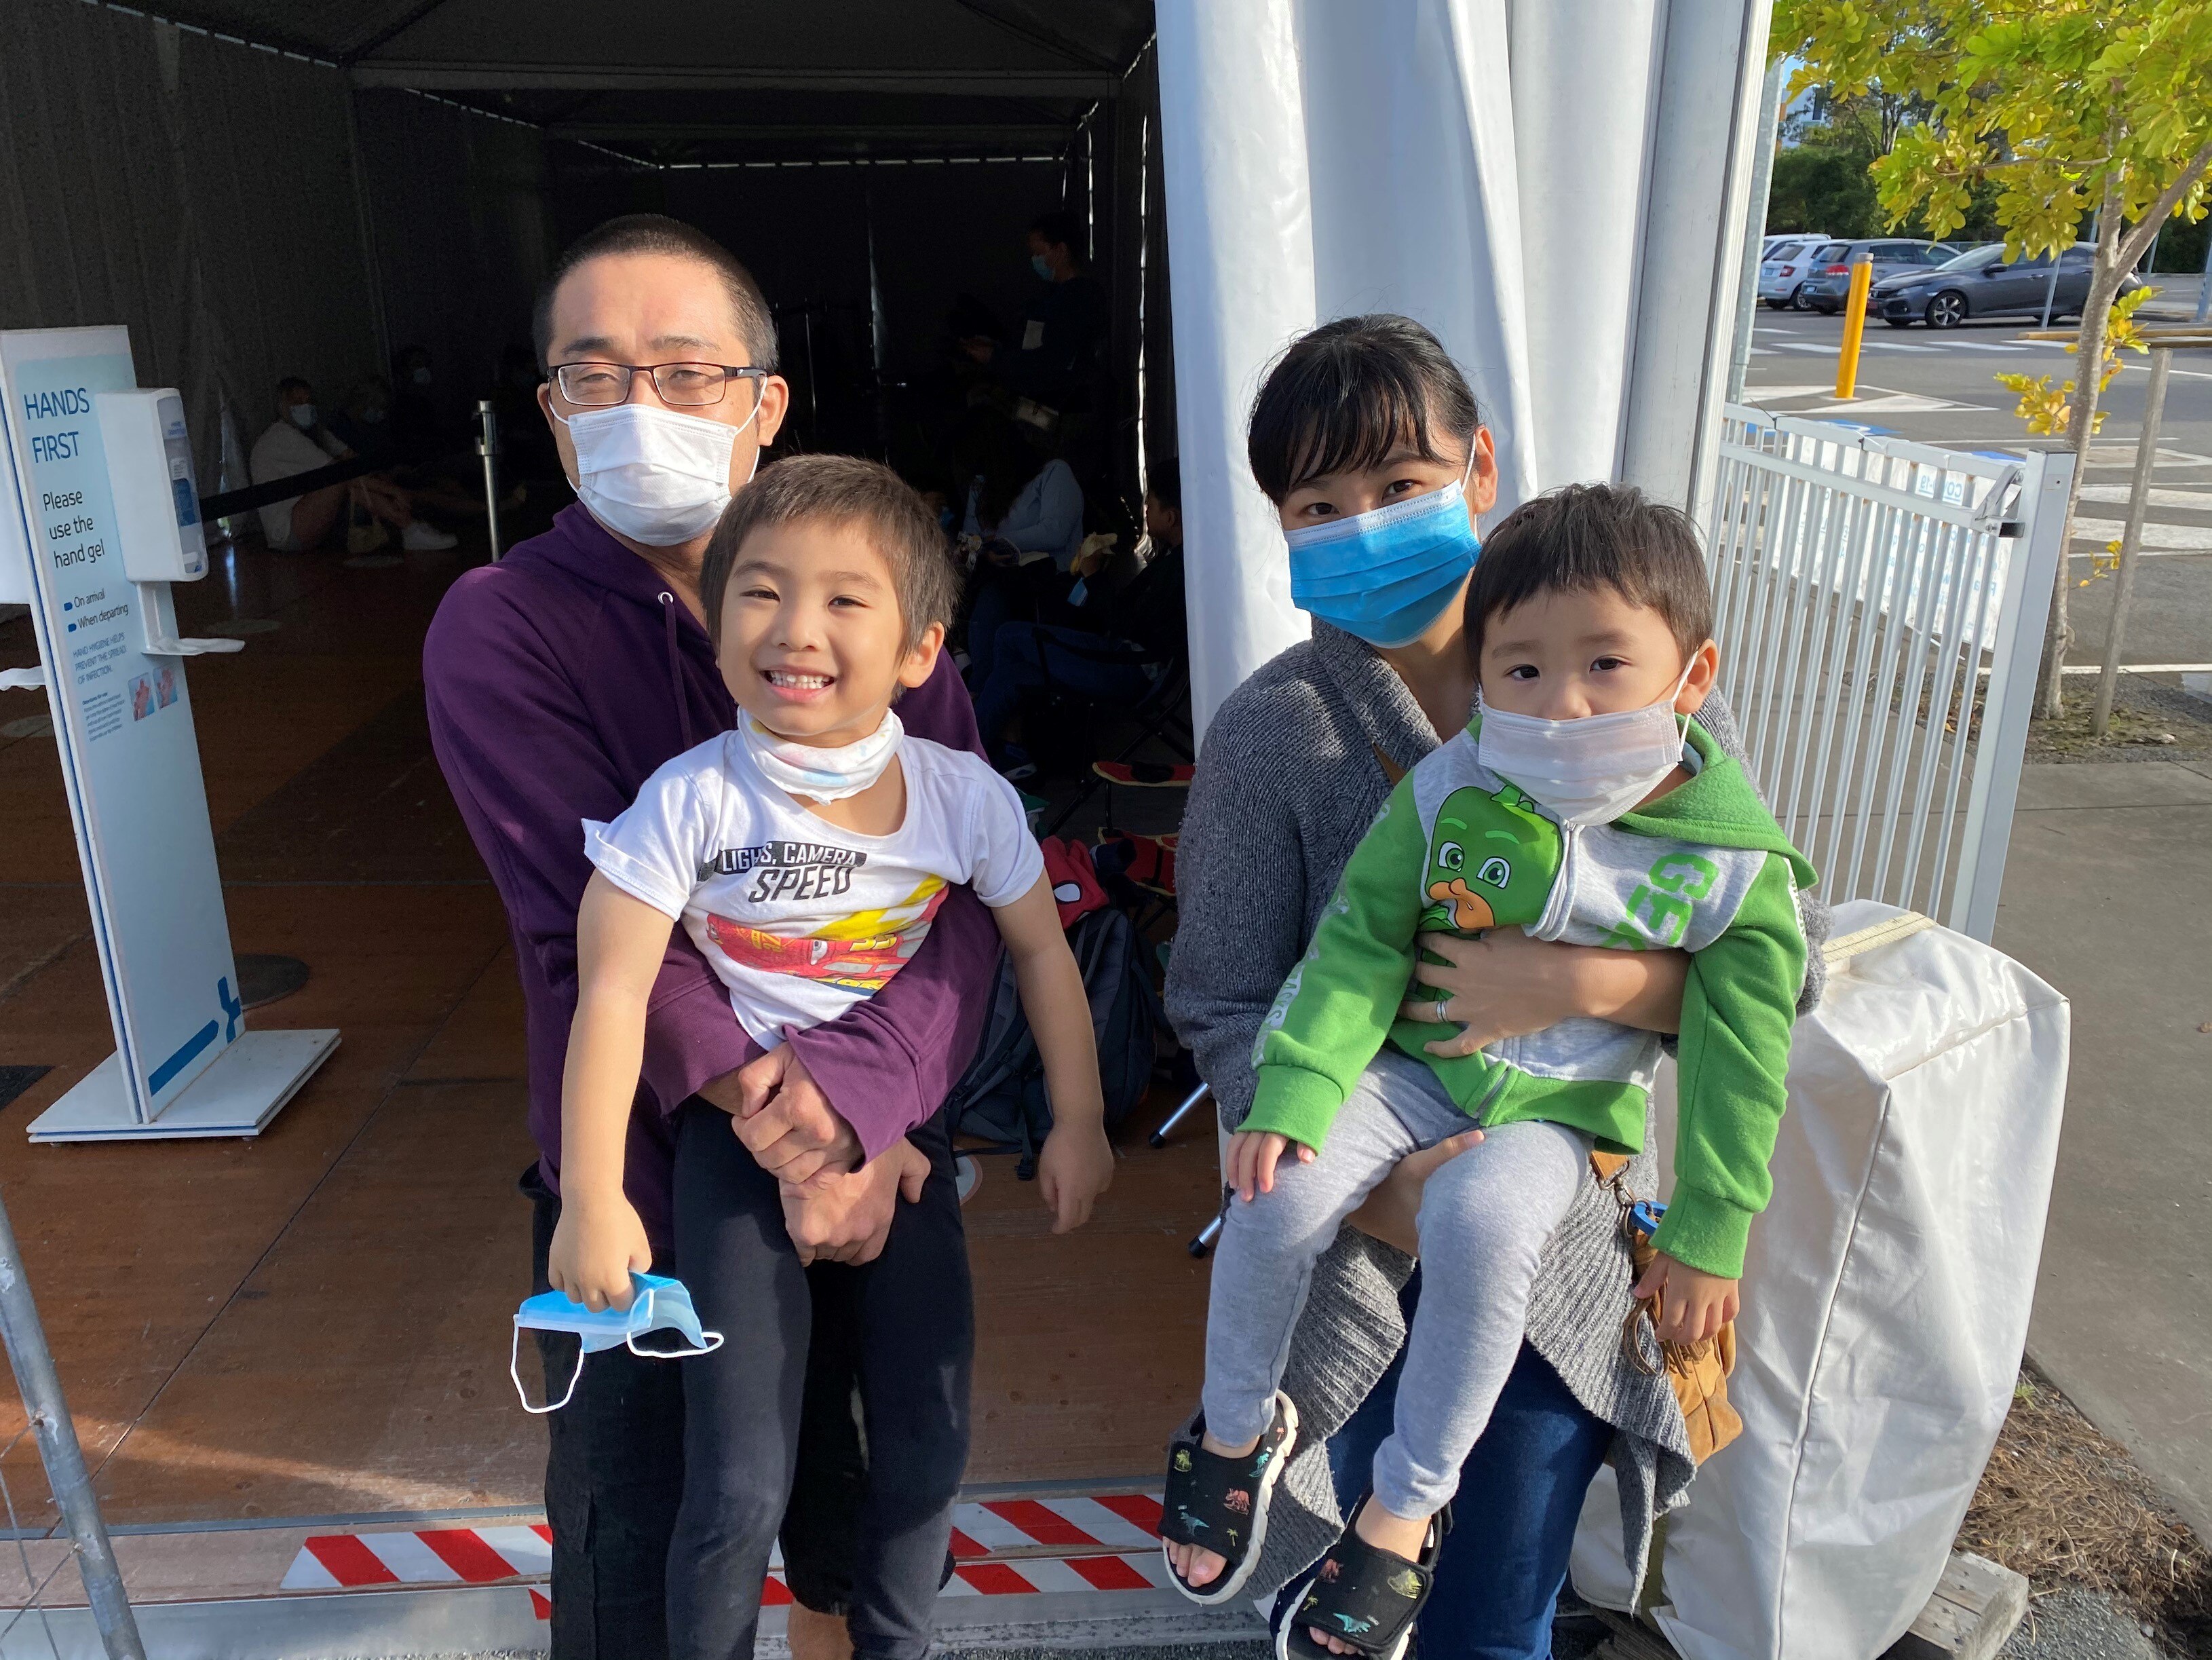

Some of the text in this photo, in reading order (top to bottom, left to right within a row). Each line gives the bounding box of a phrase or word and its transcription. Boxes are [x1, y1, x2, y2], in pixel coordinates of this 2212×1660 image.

[24, 388, 90, 420] HANDS
[32, 431, 79, 463] FIRST
[43, 491, 83, 512] Please
[49, 514, 94, 540] use the
[53, 538, 105, 569] hand gel
[74, 588, 105, 608] On arrival
[77, 605, 129, 629] When departing
[748, 865, 856, 903] SPEED
